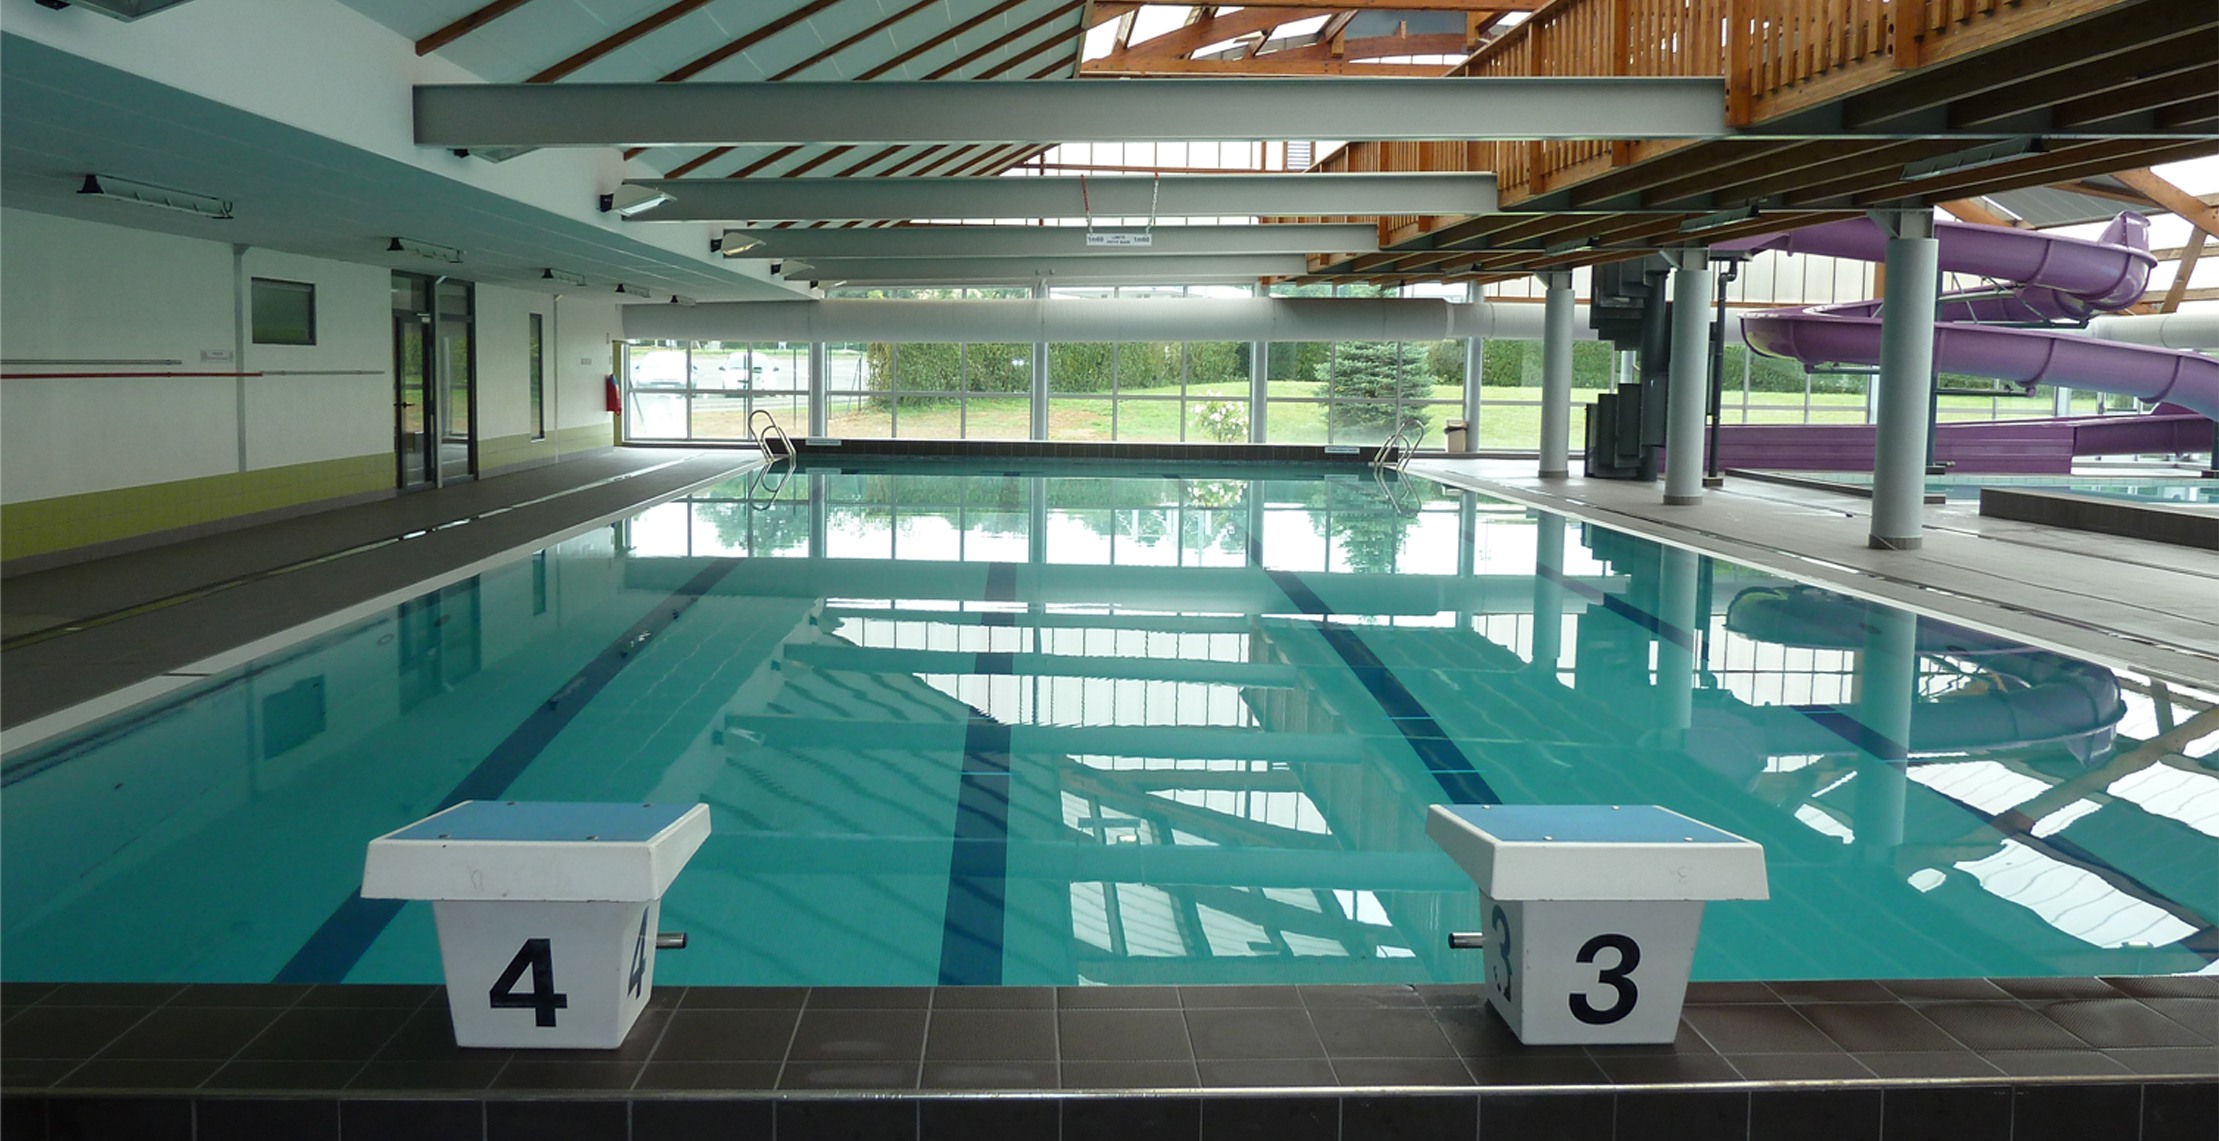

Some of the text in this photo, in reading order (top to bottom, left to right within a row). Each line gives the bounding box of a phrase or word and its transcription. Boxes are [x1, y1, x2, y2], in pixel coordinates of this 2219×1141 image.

[489, 938, 567, 1027] 4
[627, 905, 649, 1000] 4
[1491, 904, 1512, 1002] 3
[1568, 933, 1641, 1025] 3
